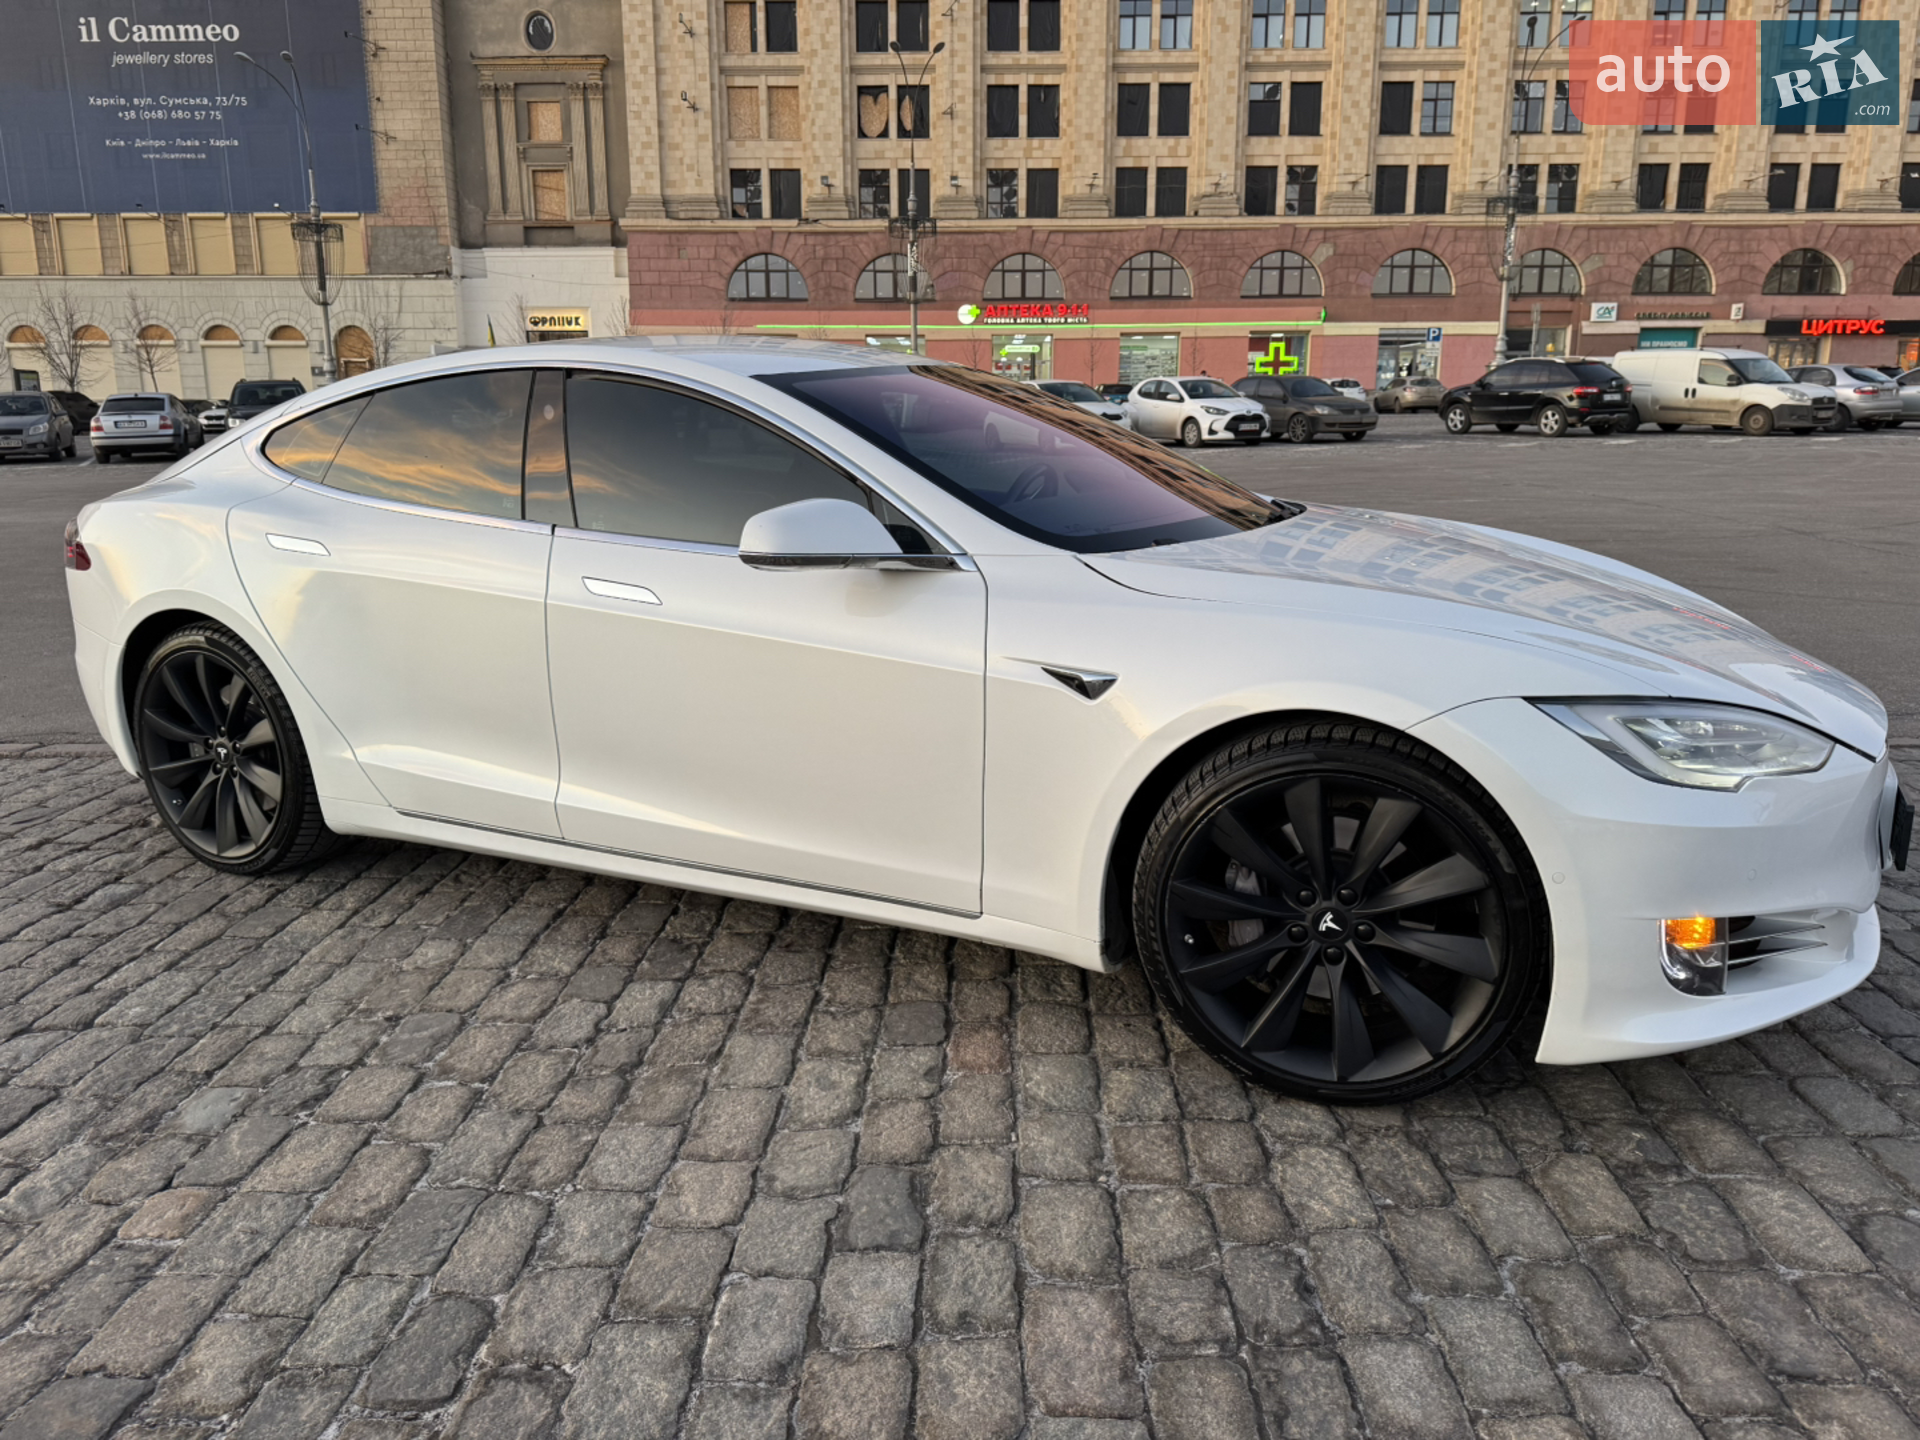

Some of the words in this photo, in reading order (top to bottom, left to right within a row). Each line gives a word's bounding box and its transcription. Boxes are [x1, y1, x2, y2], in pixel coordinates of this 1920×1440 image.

[78, 17, 101, 42] il
[108, 16, 240, 42] Cammeo
[111, 51, 170, 68] jewellery
[173, 52, 214, 64] stores
[88, 95, 130, 107] Харків,
[133, 96, 157, 107] вул.
[159, 95, 212, 107] Сумська,
[215, 94, 248, 106] 73/75
[117, 110, 136, 120] +38
[139, 110, 168, 120] (068)
[170, 110, 191, 119] 680
[194, 111, 206, 120] 57
[209, 111, 222, 120] 75
[984, 304, 1054, 317] АПТЕКА
[1801, 319, 1886, 336] ЦИТРУС
[1429, 328, 1440, 341] P
